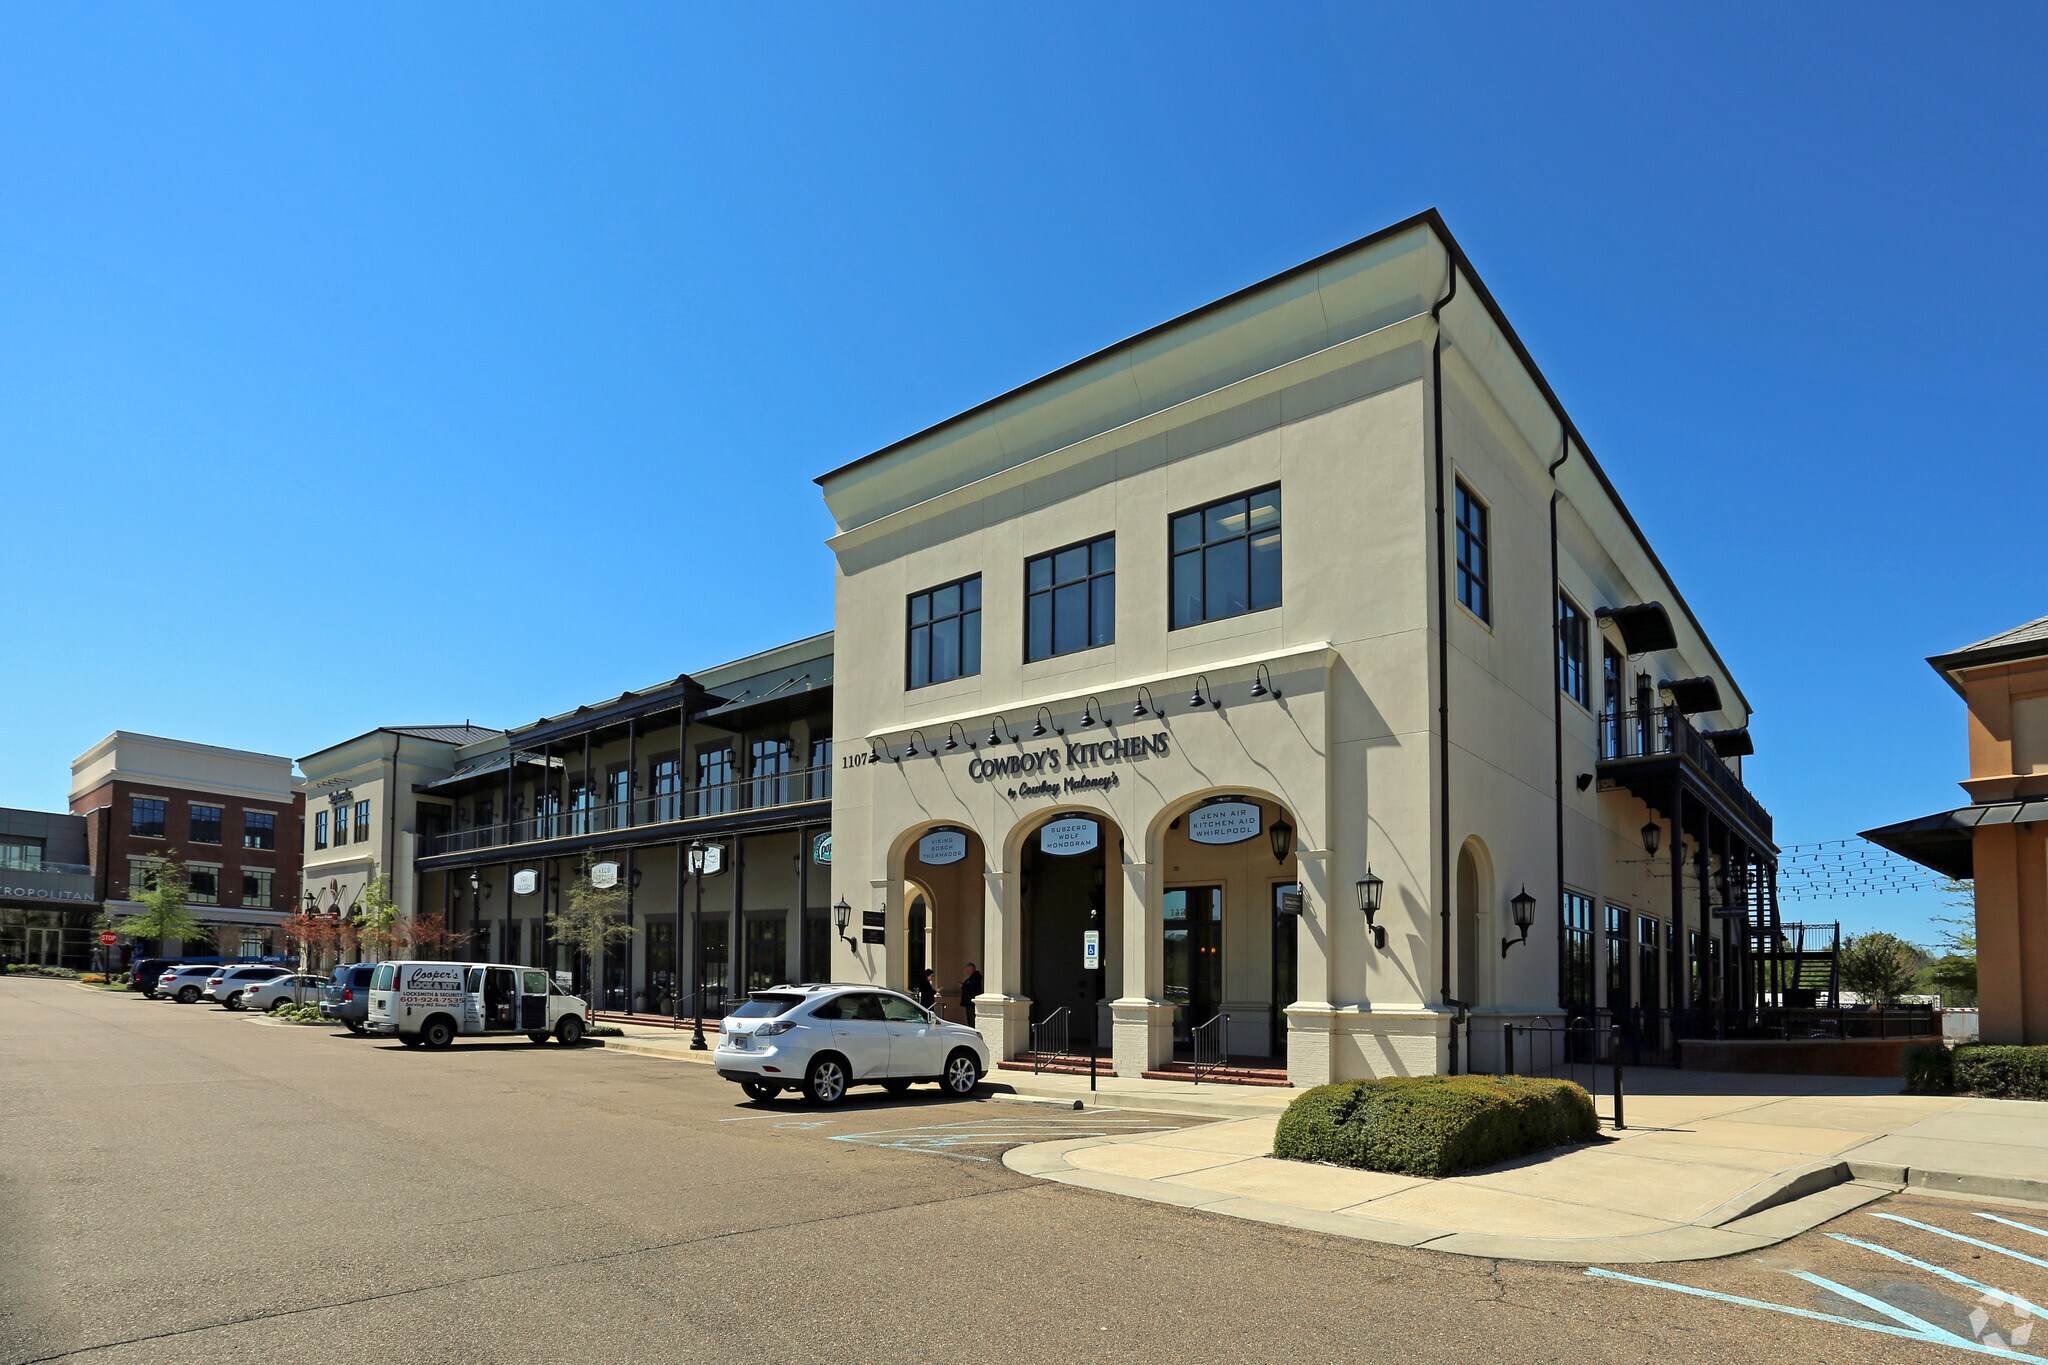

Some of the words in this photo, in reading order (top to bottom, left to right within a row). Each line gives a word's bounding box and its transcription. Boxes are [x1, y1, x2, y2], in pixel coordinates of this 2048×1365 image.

[842, 752, 868, 769] 1107
[968, 747, 1059, 779] COWBOY'S
[1065, 732, 1168, 766] KITCHENS
[1007, 787, 1017, 797] by
[1019, 780, 1060, 796] Cowboy
[1063, 771, 1118, 791] Maloney's
[1201, 811, 1226, 820] JENN
[1230, 809, 1247, 817] AIR
[1051, 824, 1087, 833] SUBZERO
[1193, 819, 1234, 829] KITCHEN
[1058, 832, 1080, 840] WOLF
[1196, 827, 1252, 837] WHIRLPOOL
[1047, 840, 1091, 849] MONOGRAM
[923, 851, 962, 859] THERMADOR
[411, 967, 459, 982] Cooper's
